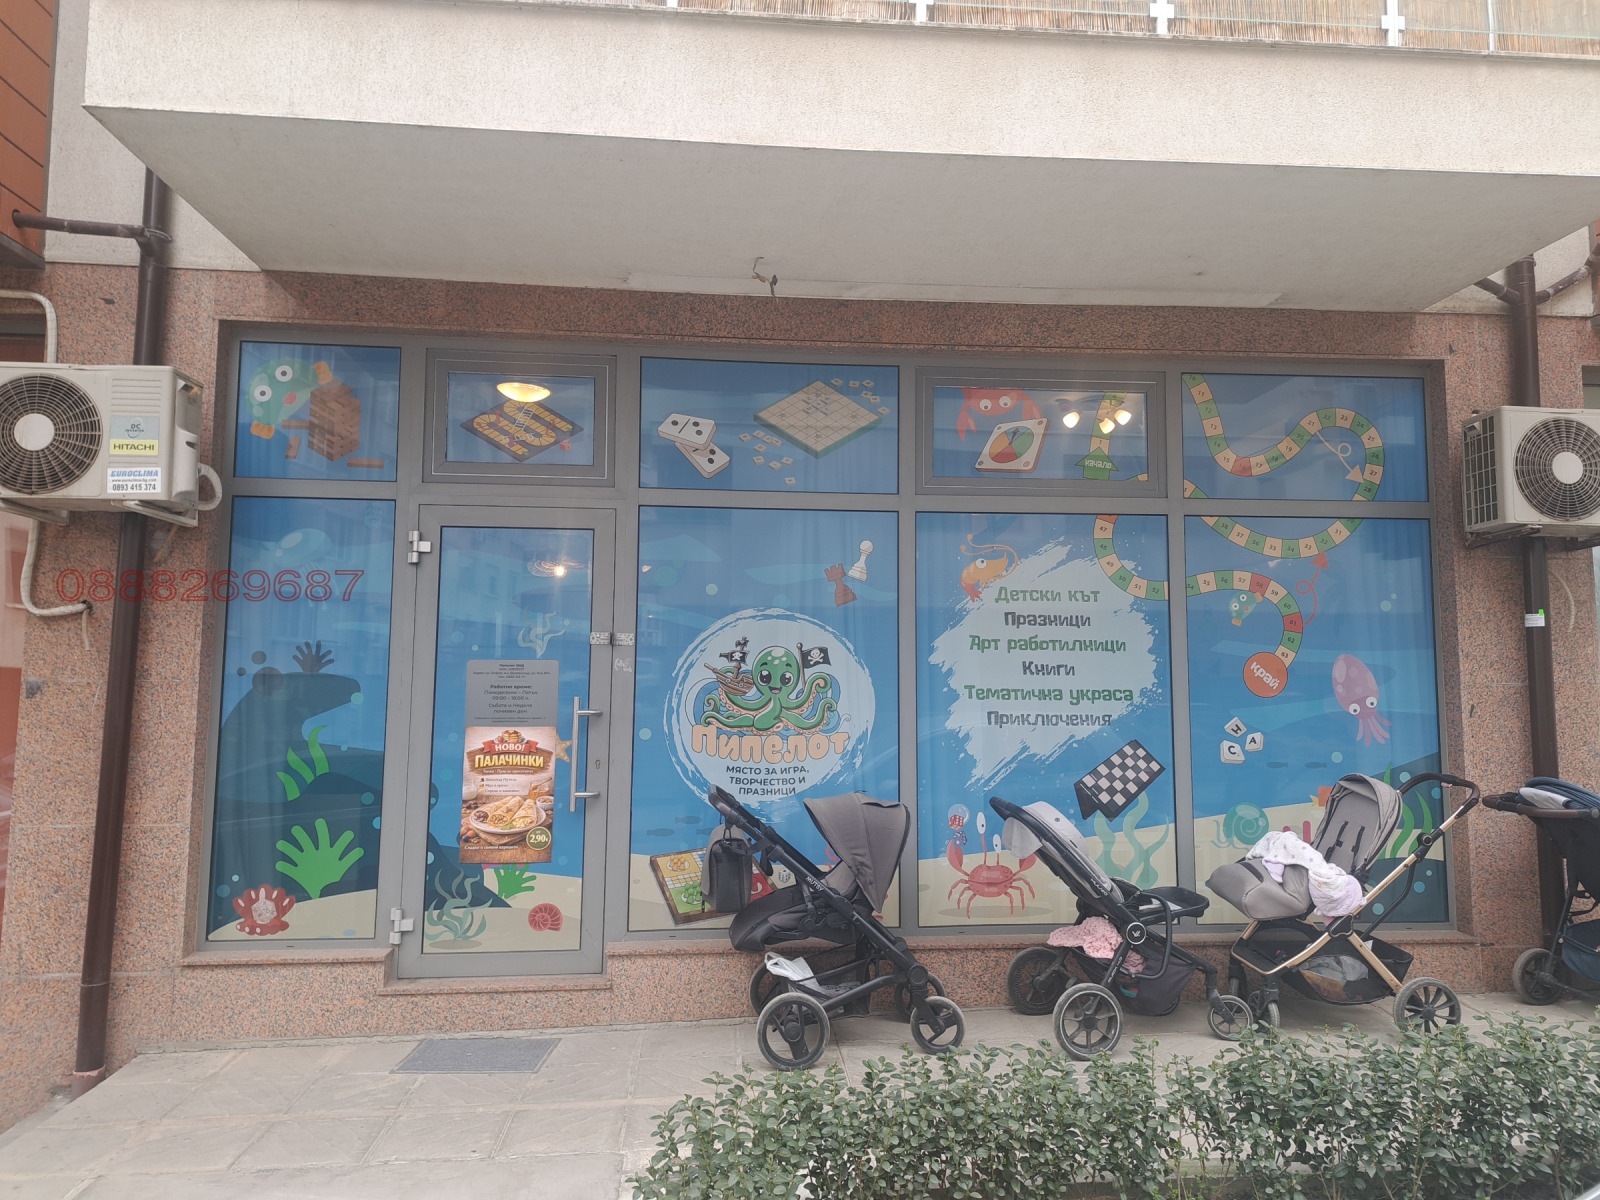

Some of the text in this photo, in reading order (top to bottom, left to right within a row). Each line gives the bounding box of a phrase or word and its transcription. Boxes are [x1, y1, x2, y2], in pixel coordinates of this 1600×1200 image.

[113, 443, 155, 451] HITACHI
[1085, 459, 1112, 469] начало
[994, 586, 1100, 603] Детски кът
[1004, 611, 1091, 629] Празници
[969, 634, 1127, 654] Арт работилници
[1022, 661, 1076, 677] Книги
[1250, 661, 1281, 690] край
[964, 684, 1134, 706] Тематична украса
[986, 710, 1112, 728] Приключения
[691, 724, 850, 764] Пипелот
[1249, 736, 1257, 745] А
[495, 744, 525, 752] НОВО!
[1228, 745, 1236, 755] С
[475, 755, 544, 768] ПАЛАЧИНКИ
[726, 765, 810, 776] МЯСТО ЗА ИГРА,
[729, 776, 806, 787] ТВОРЧЕСТВО И
[738, 786, 796, 797] ПРАЗНИЦИ
